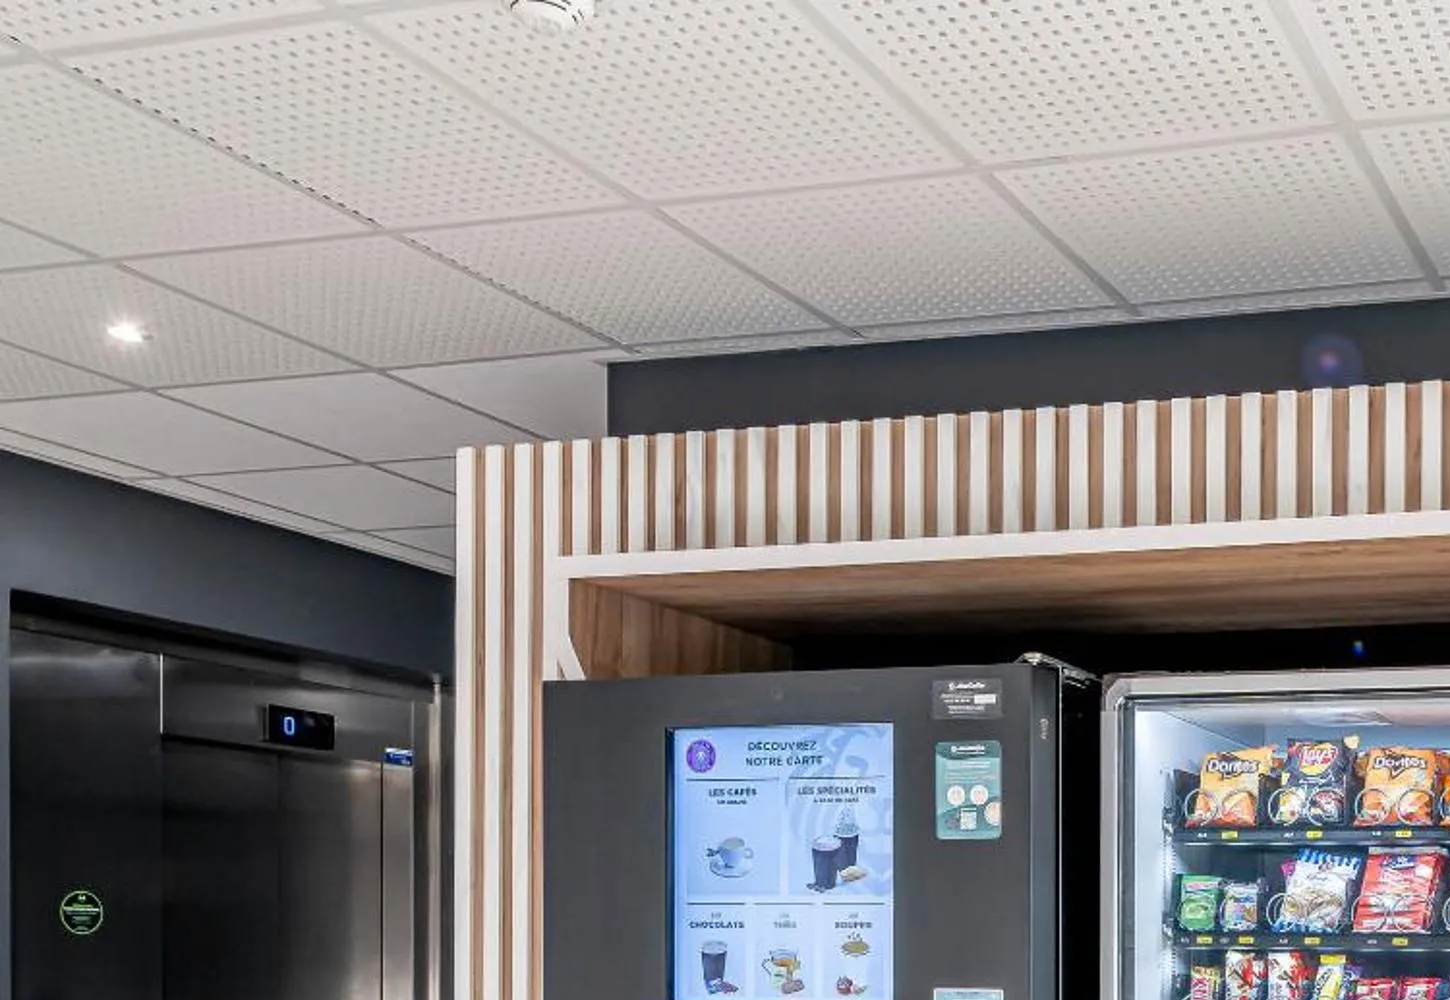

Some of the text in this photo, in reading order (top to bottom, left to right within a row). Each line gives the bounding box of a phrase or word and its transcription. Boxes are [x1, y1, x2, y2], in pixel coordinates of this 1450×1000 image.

[283, 716, 295, 736] 0
[745, 754, 823, 767] NOTRE CARTE
[1207, 758, 1258, 775] Doritos
[1373, 756, 1426, 769] Doritos
